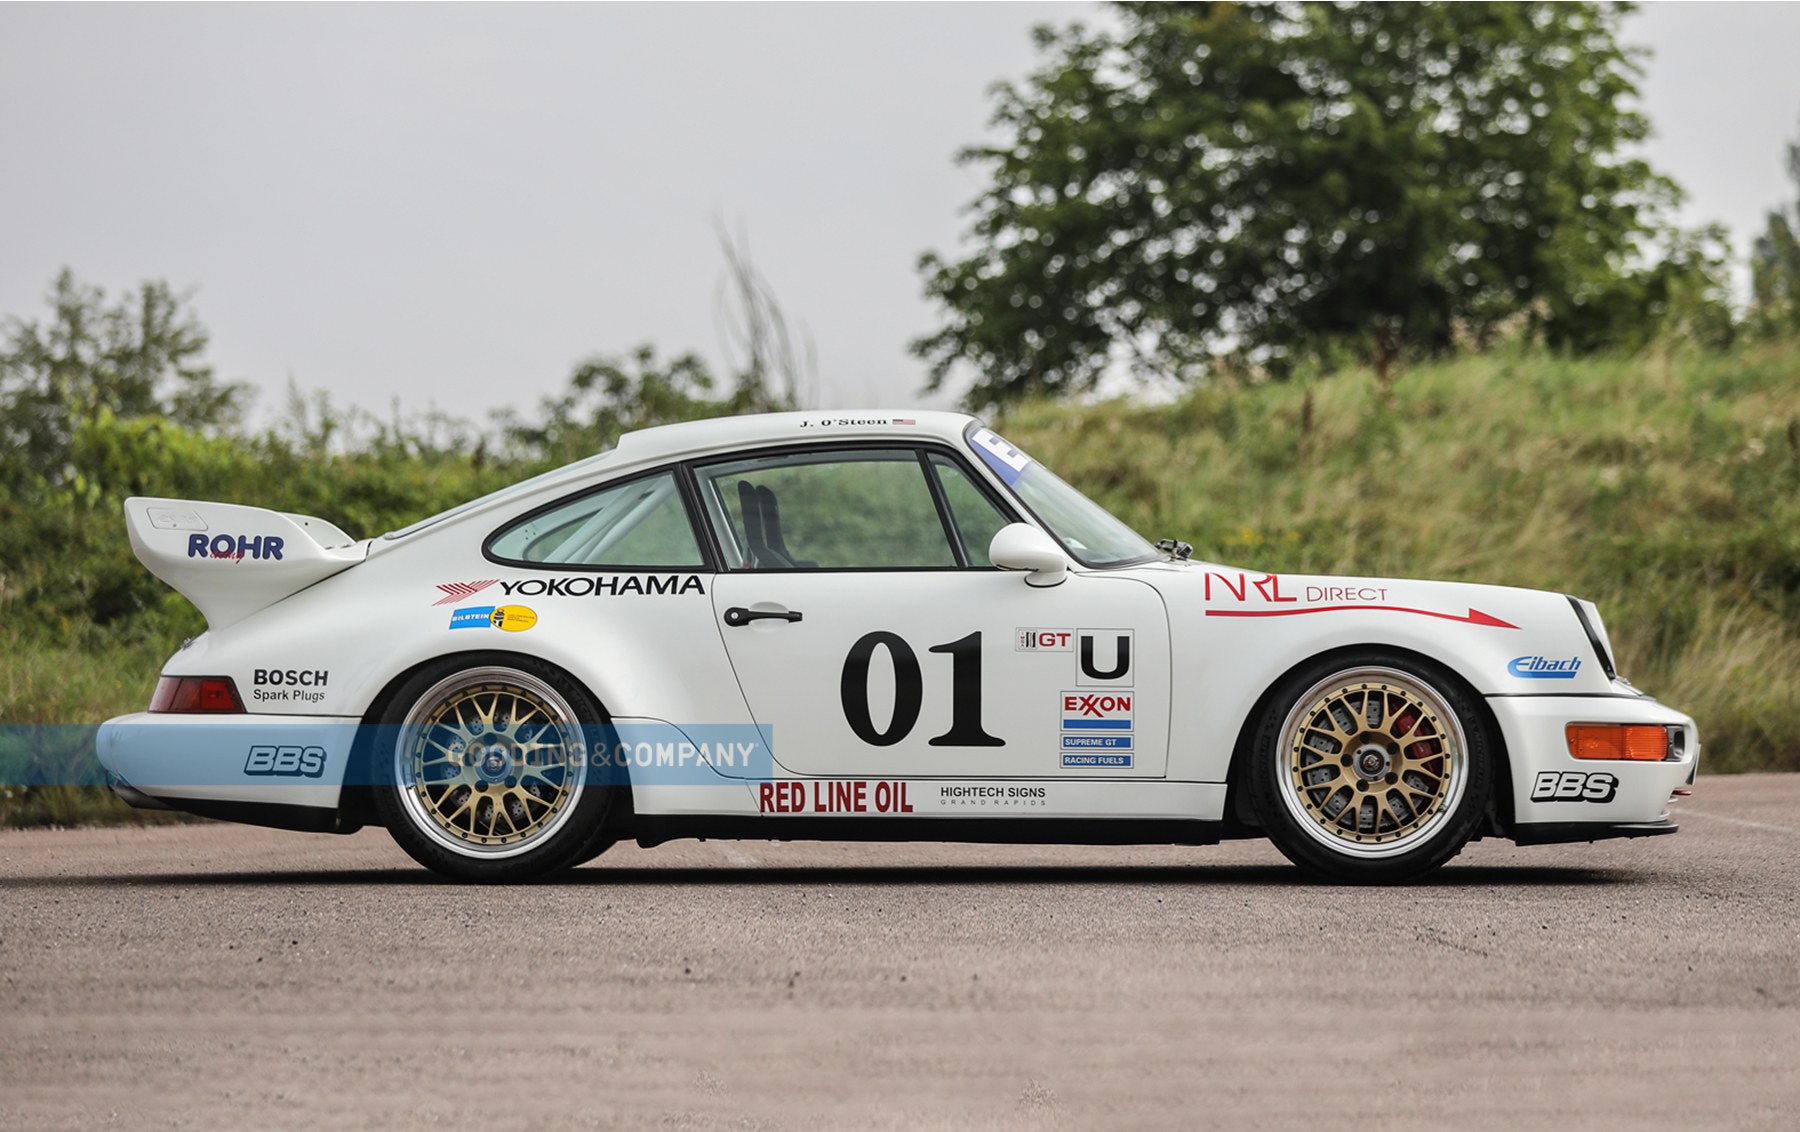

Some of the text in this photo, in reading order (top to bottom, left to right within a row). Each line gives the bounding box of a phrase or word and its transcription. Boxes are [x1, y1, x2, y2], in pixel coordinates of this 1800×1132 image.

[799, 420, 814, 428] J.
[187, 533, 284, 560] ROHR
[500, 575, 706, 596] YOKOHAMA
[1306, 586, 1388, 602] DIRECT
[1039, 632, 1071, 647] GT
[1080, 635, 1130, 680] U
[1507, 656, 1582, 679] Eibach
[253, 669, 329, 687] BOSCH
[840, 630, 1006, 747] 01
[253, 688, 325, 703] Spark Plugs
[1064, 693, 1131, 718] EXXON
[1064, 738, 1118, 746] SUPREME GT
[243, 745, 327, 778] BBS
[760, 781, 914, 813] RED LINE OIL
[940, 786, 1046, 798] HIGHTECH SIGNS
[1531, 771, 1619, 803] BBS
